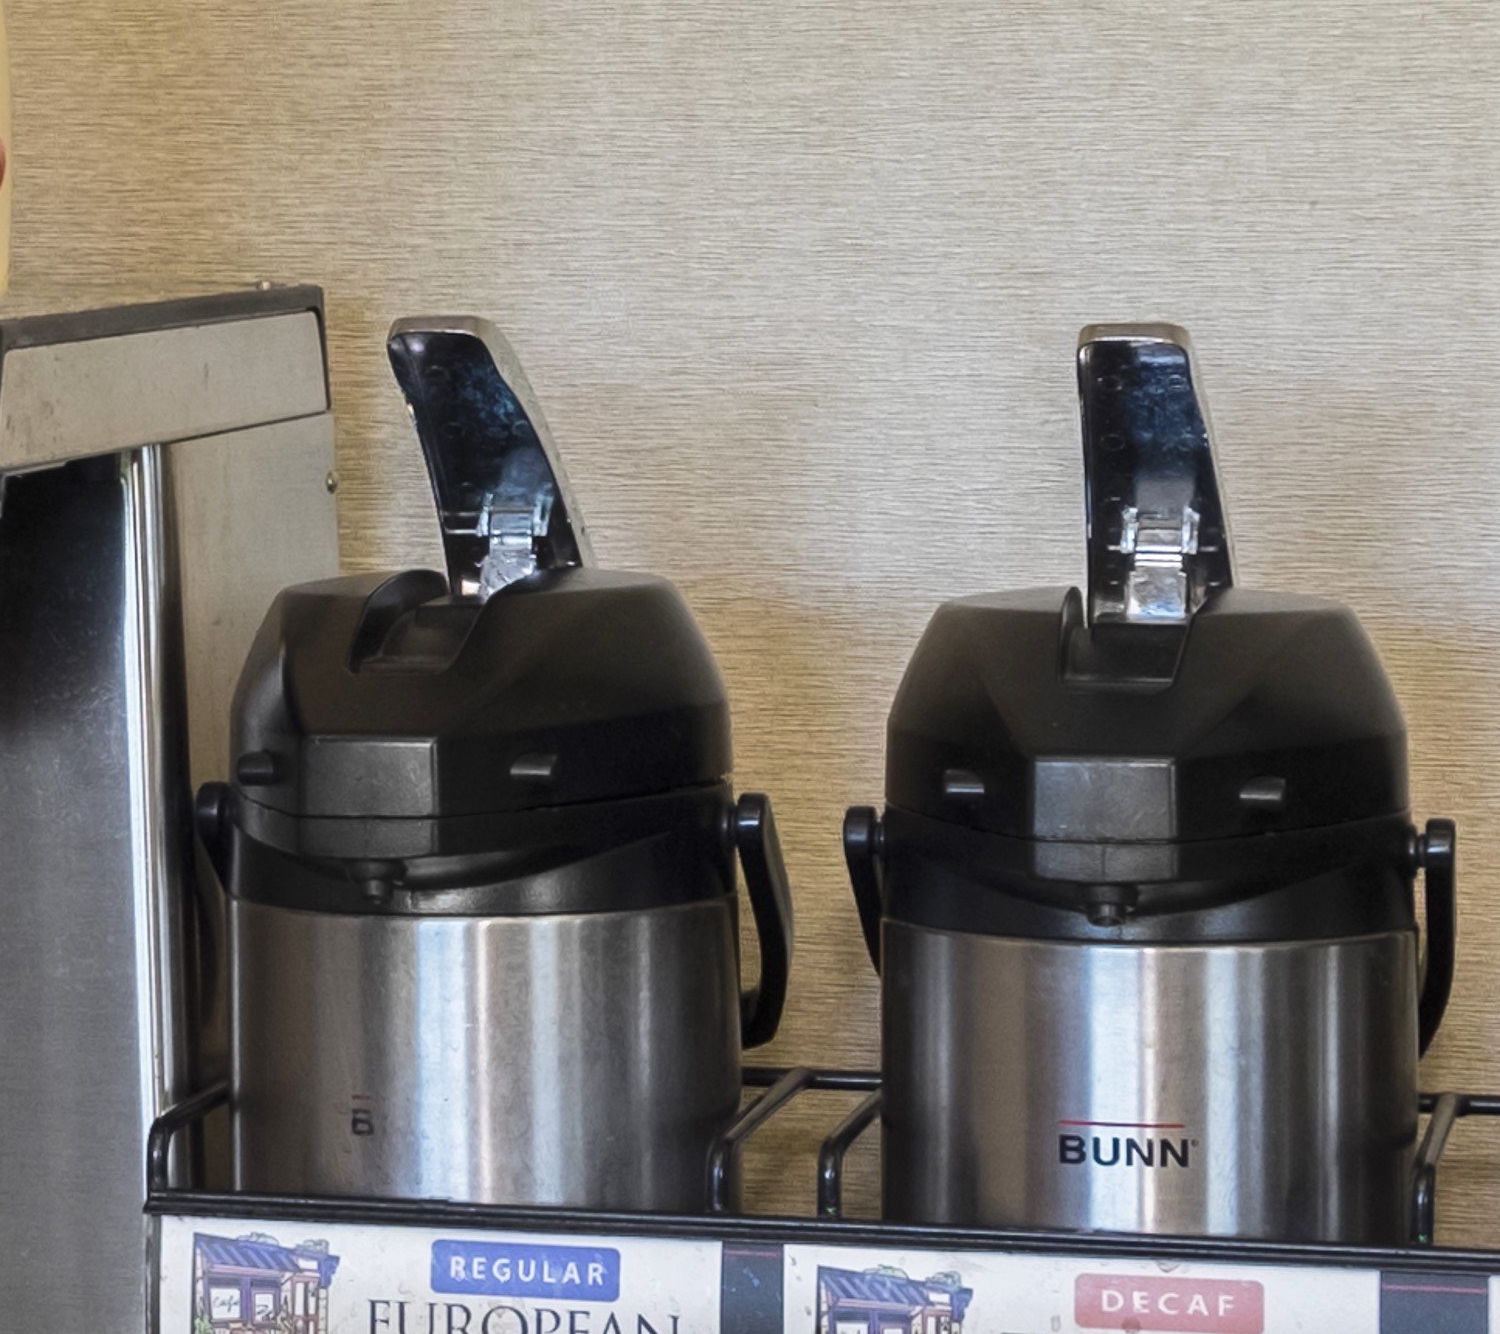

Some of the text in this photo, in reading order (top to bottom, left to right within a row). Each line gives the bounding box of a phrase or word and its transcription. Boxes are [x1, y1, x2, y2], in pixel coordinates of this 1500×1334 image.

[1059, 1134, 1190, 1168] BUNN
[450, 1255, 605, 1287] REGULAR
[1100, 1288, 1235, 1316] DECAF
